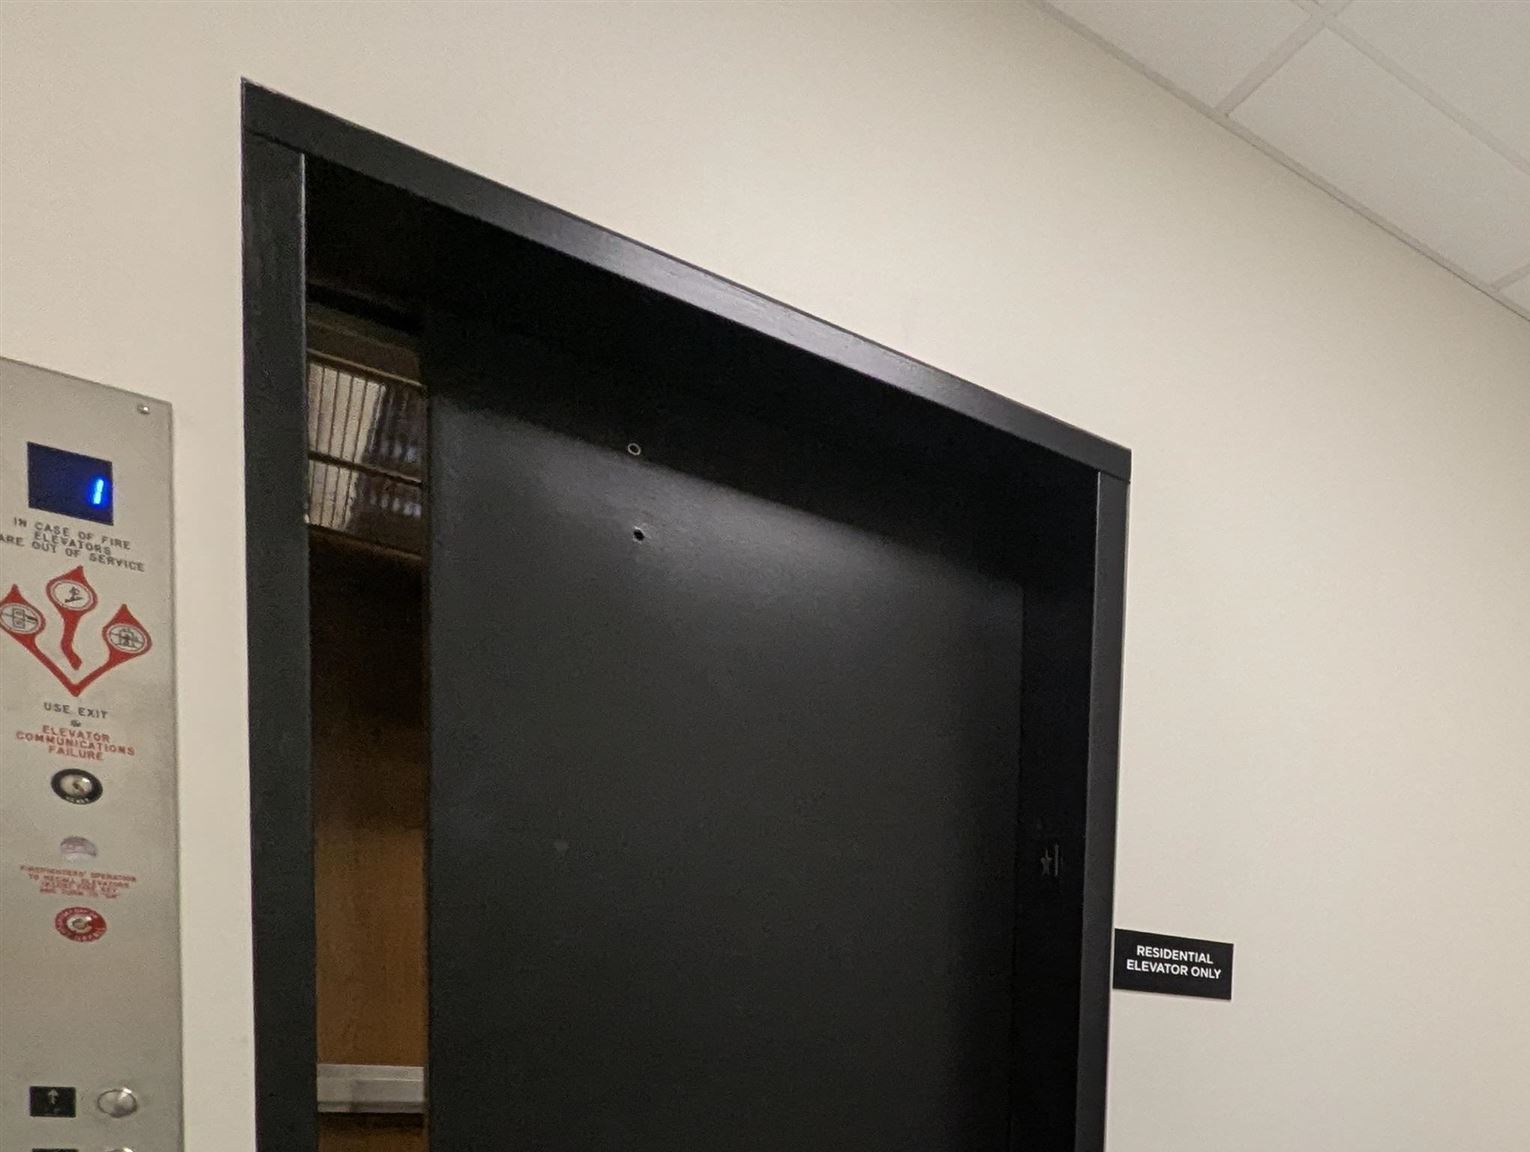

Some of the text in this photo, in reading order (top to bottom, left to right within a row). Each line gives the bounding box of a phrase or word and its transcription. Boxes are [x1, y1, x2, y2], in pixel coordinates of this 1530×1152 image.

[93, 478, 104, 504] 1
[13, 517, 131, 550] IN CASE OF FIRE
[34, 531, 112, 555] ELEVATORS
[31, 541, 57, 553] OUT
[65, 548, 80, 558] OF
[89, 553, 145, 572] SERVICE
[43, 702, 108, 719] USE EXIT
[15, 730, 136, 756] COMMUNICATIONS
[42, 725, 110, 742] ELEVATOR
[48, 746, 104, 761] FAILURE
[1136, 944, 1214, 965] RESIDENTIAL
[1126, 959, 1222, 980] ELEVATOR ONLY
